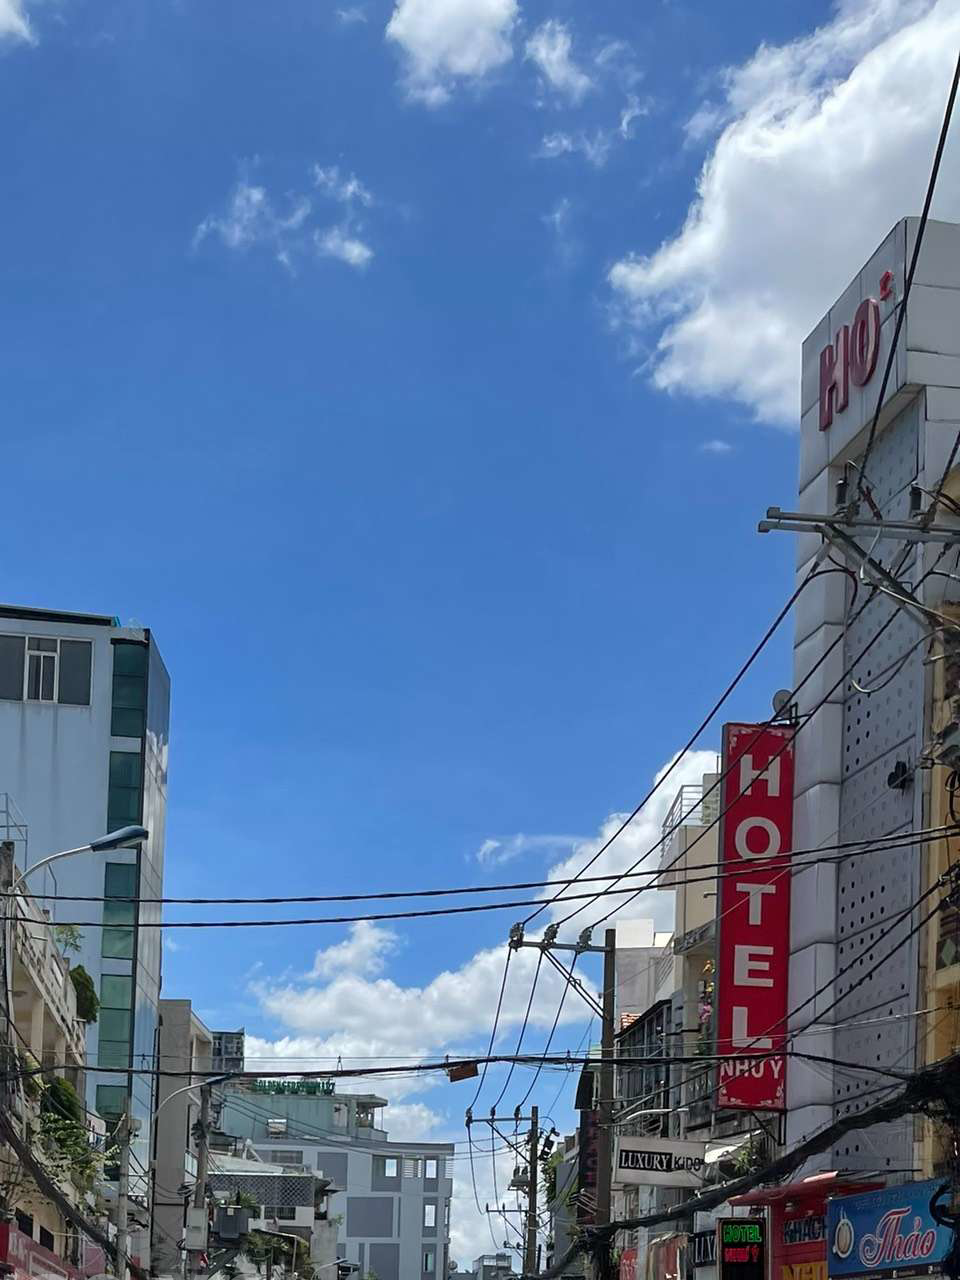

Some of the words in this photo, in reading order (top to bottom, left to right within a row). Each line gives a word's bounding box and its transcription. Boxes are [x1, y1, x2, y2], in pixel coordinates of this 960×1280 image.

[732, 754, 781, 1049] HOTEL
[621, 1152, 670, 1170] LUXURY
[723, 1224, 762, 1242] HOTEL
[859, 1206, 937, 1268] Thảo
